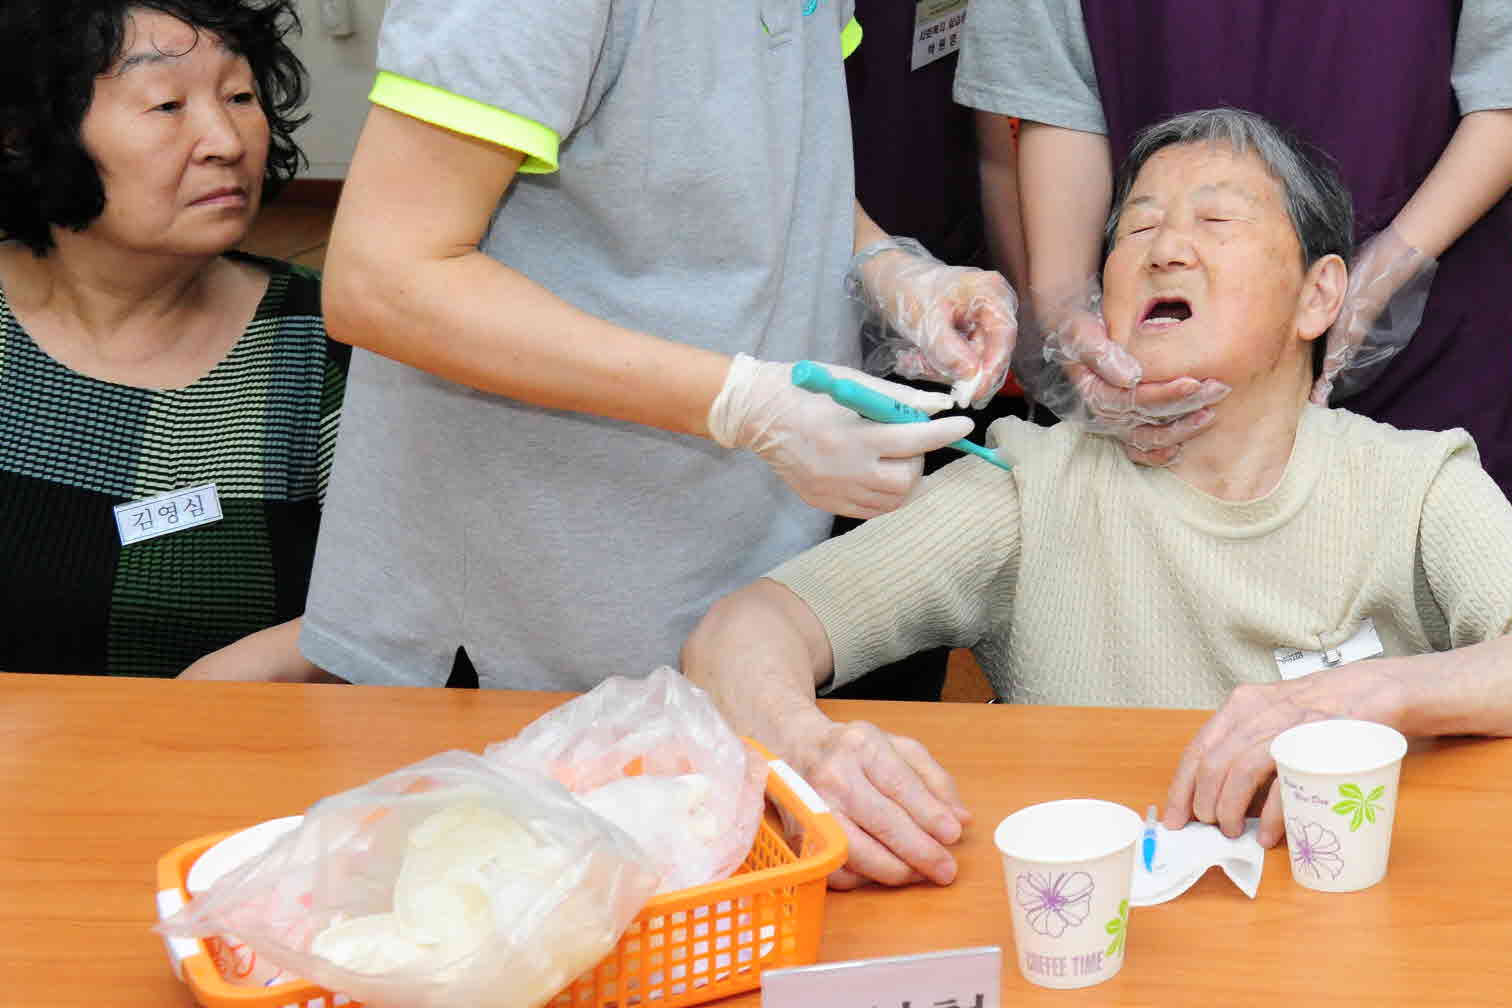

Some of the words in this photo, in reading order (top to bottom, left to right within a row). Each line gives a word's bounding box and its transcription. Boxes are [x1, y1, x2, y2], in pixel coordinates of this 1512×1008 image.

[131, 495, 205, 531] 김영심
[1023, 952, 1066, 977] COFFEE
[1072, 951, 1104, 977] TIME
